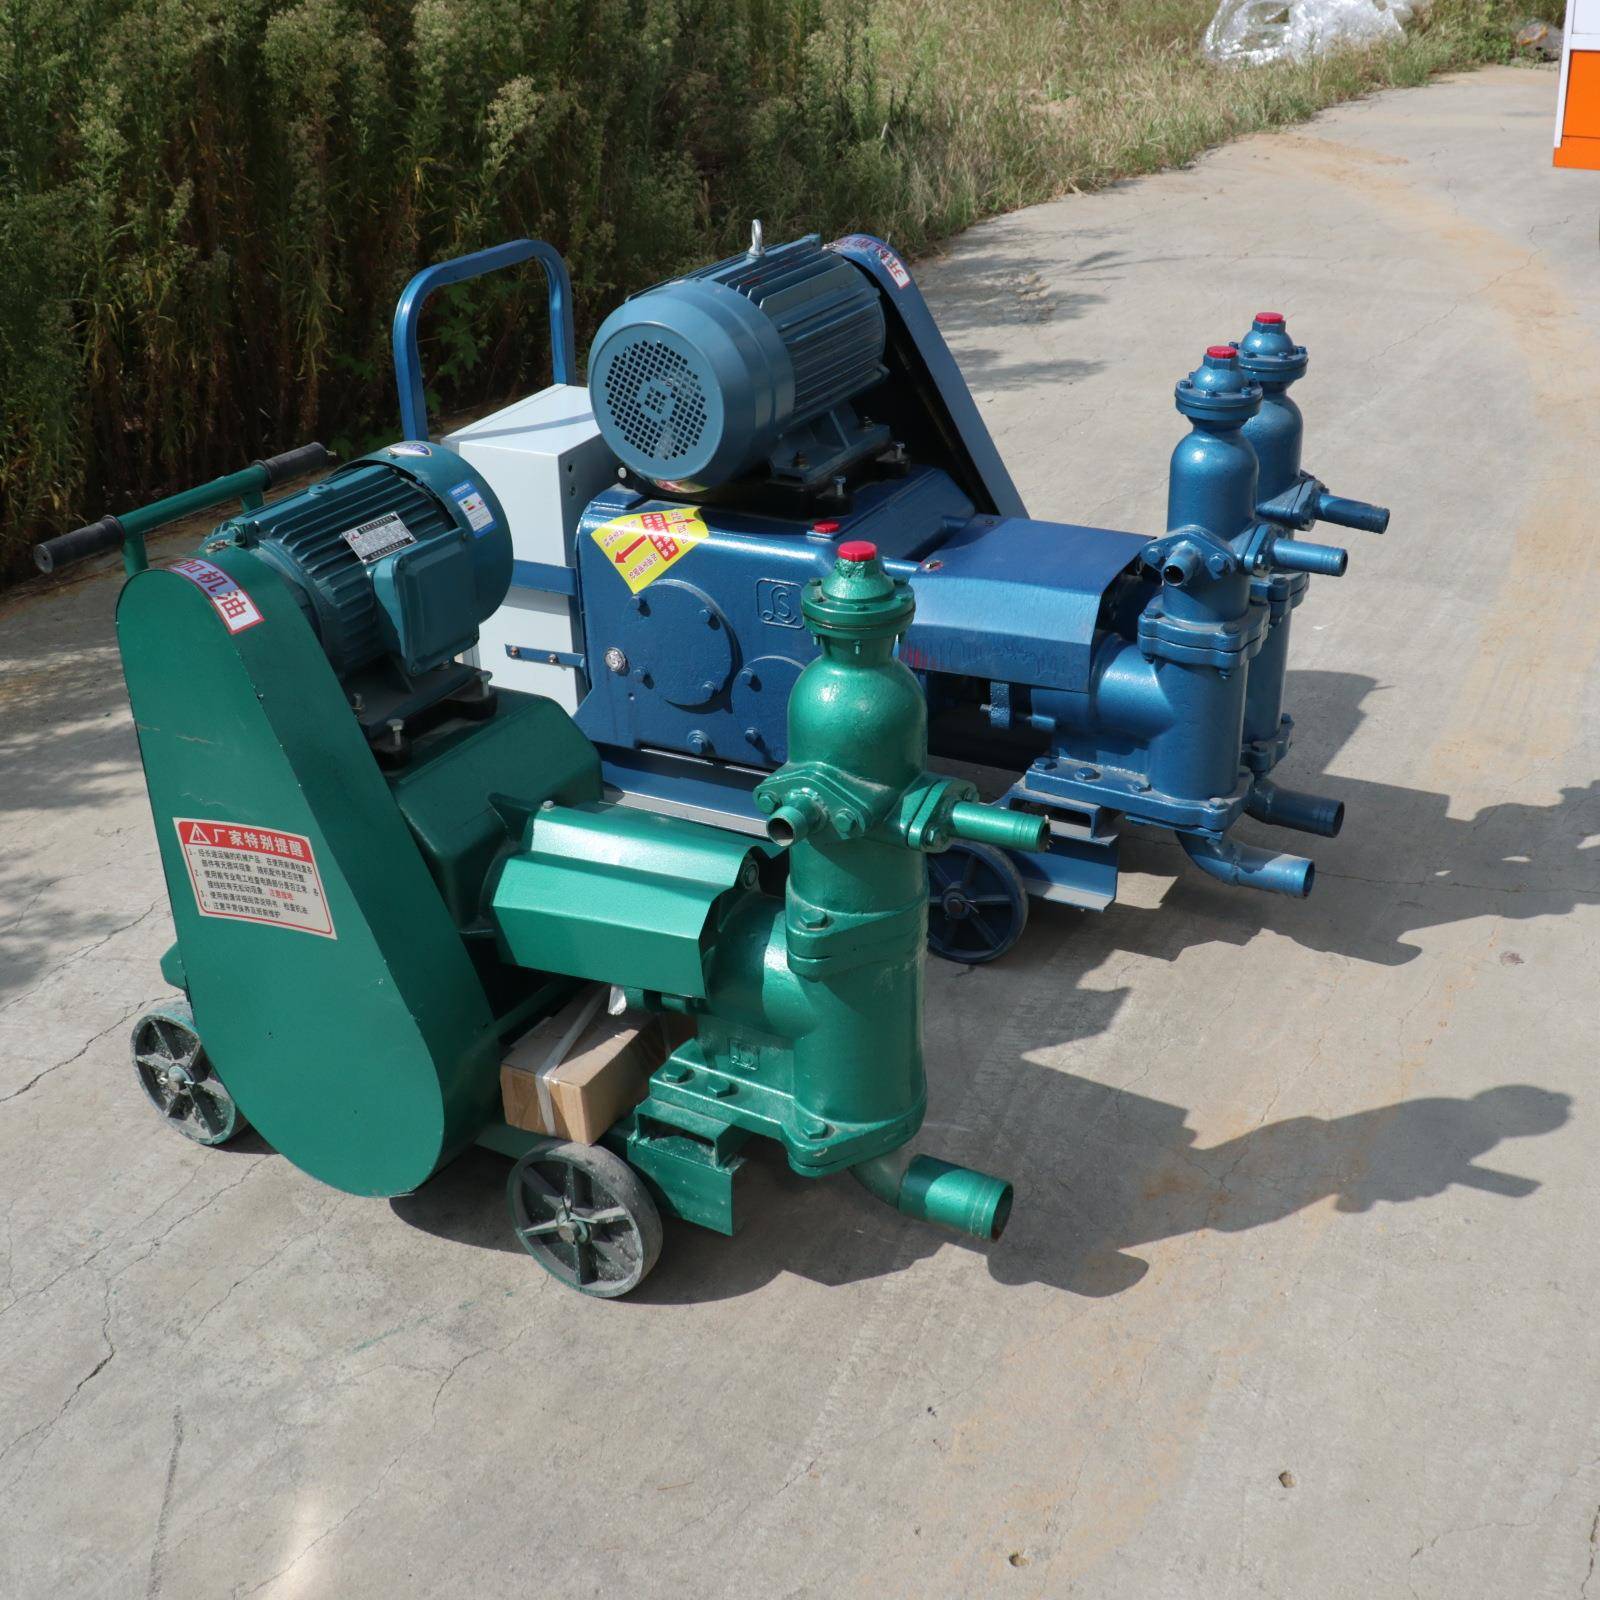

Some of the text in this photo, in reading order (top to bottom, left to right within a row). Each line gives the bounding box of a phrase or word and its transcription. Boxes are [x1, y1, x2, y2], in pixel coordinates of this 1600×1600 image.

[212, 828, 305, 858] 厂家特别提醒
